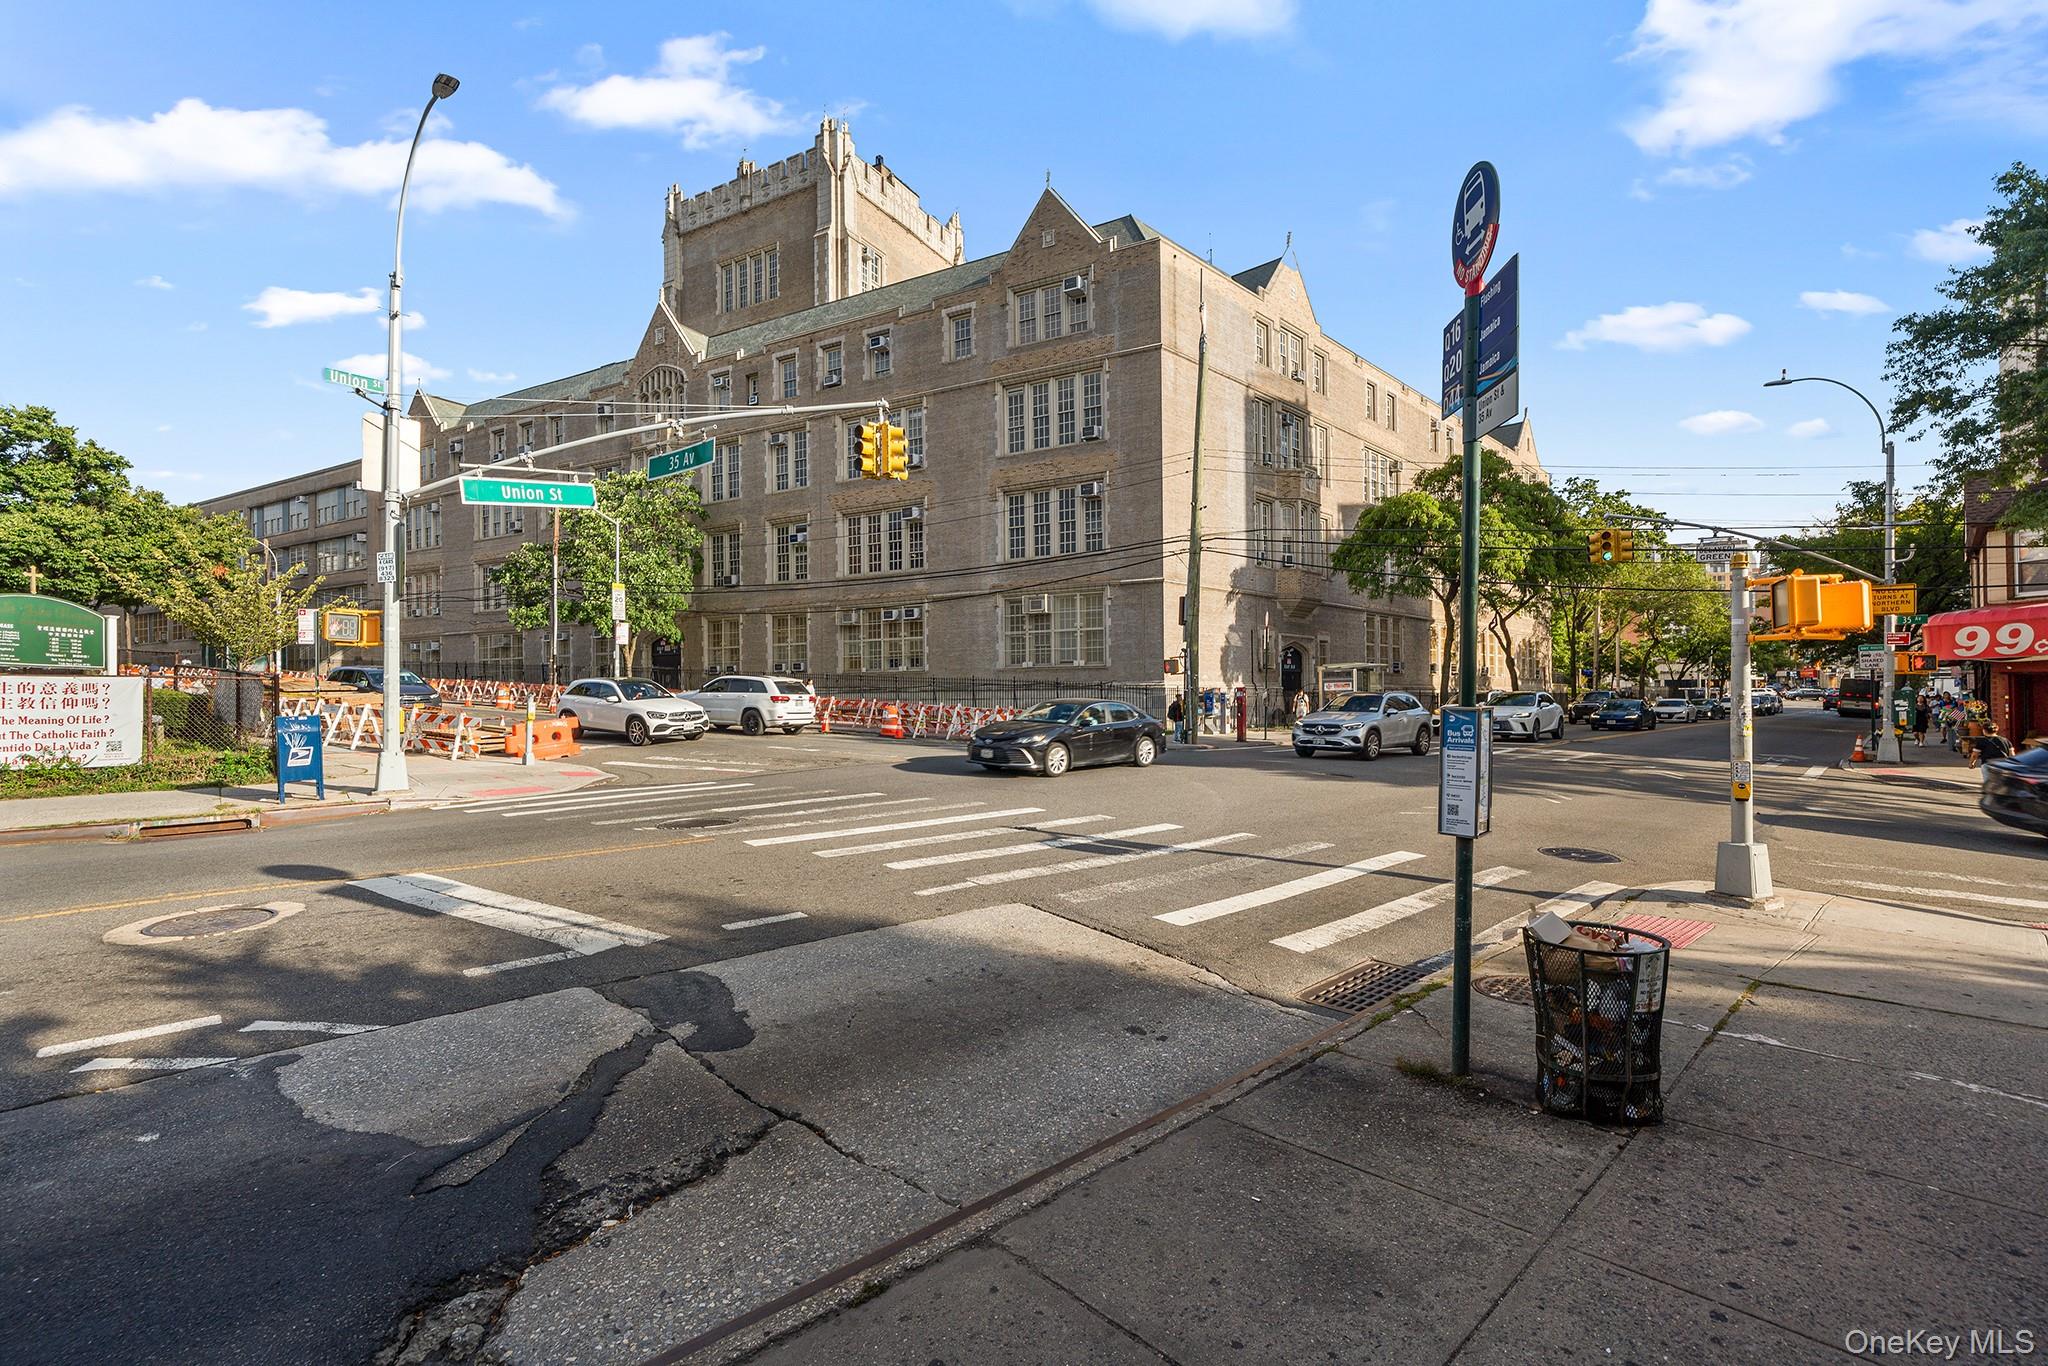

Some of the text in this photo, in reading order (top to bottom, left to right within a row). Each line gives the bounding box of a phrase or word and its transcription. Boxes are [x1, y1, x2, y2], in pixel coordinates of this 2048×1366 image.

[1465, 229, 1493, 283] STANDING
[1480, 280, 1501, 307] Flushing
[1445, 318, 1461, 351] Q16
[1479, 315, 1501, 342] Jamaica
[1443, 349, 1463, 383] Q20
[1479, 350, 1501, 375] Jamaica
[330, 369, 382, 389] Union St
[1478, 393, 1493, 412] Union
[1493, 387, 1501, 402] St
[1477, 409, 1493, 425] 35 Av
[668, 452, 695, 471] 35 Av
[501, 485, 563, 501] Union St
[1700, 552, 1731, 560] GREEN
[1903, 616, 1912, 624] 35
[0, 716, 15, 725] he
[18, 716, 64, 726] Meaning
[67, 715, 81, 724] Of
[9, 731, 30, 740] The
[33, 729, 79, 739] Catholic
[0, 743, 32, 752] ntido
[35, 743, 50, 752] De
[53, 742, 65, 751] La
[1576, 926, 1613, 943] CVS
